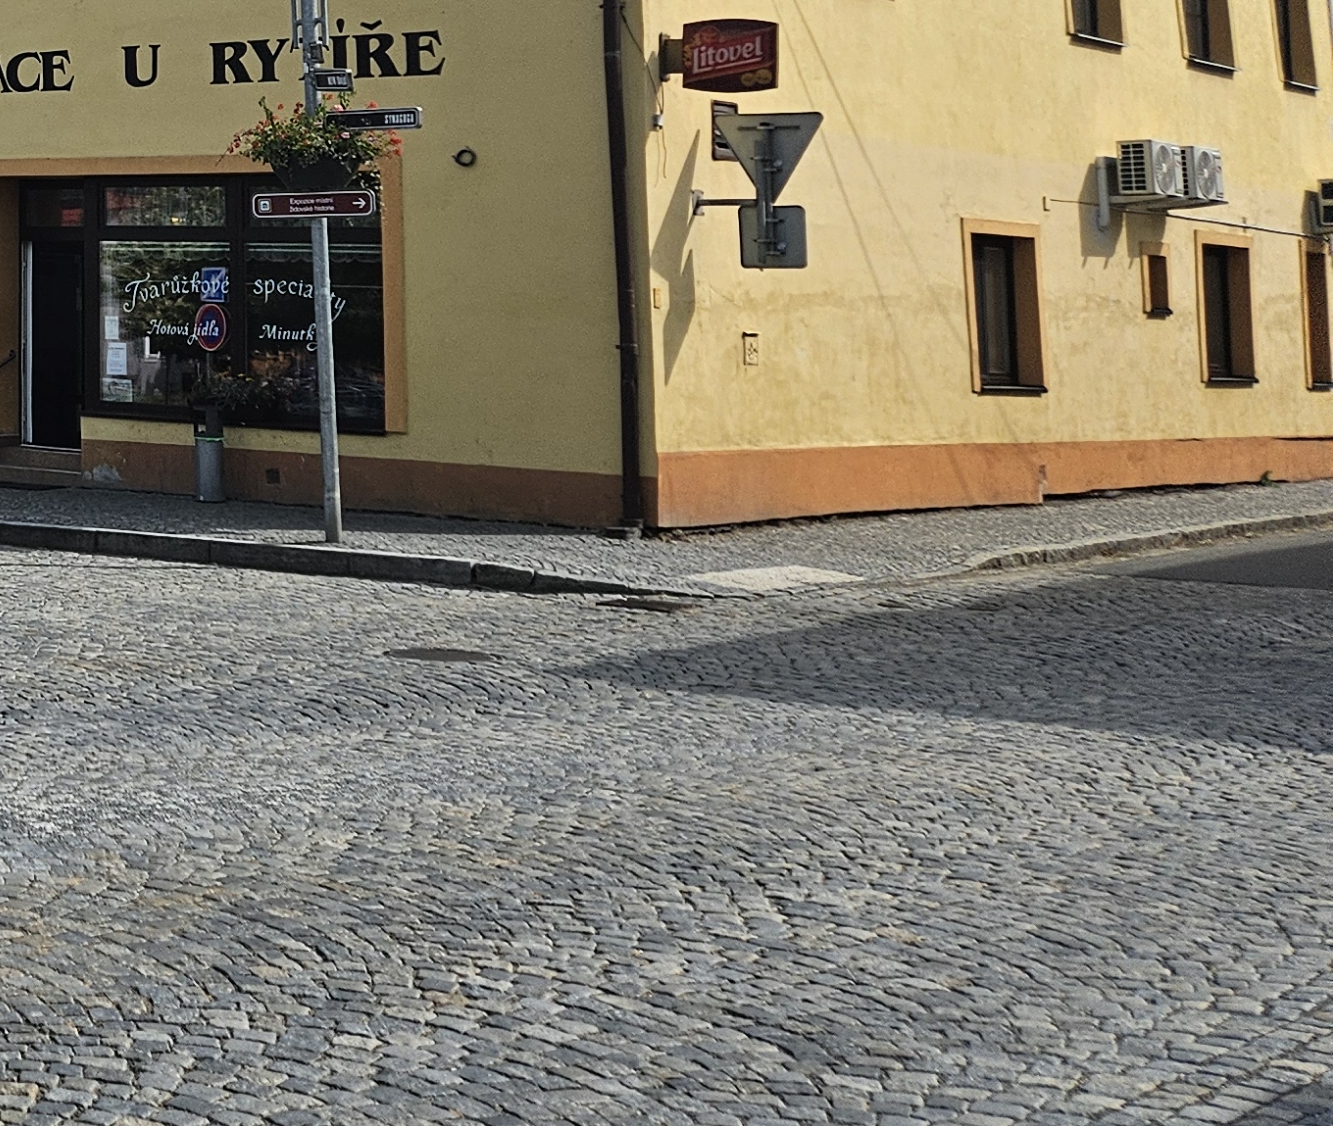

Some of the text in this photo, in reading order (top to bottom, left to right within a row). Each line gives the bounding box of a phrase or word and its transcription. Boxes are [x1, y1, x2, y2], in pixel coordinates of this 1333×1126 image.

[121, 43, 161, 89] U
[693, 35, 763, 74] Litovel
[123, 272, 347, 321] Tvarůžkové speciay
[146, 319, 219, 345] Hotová jídla
